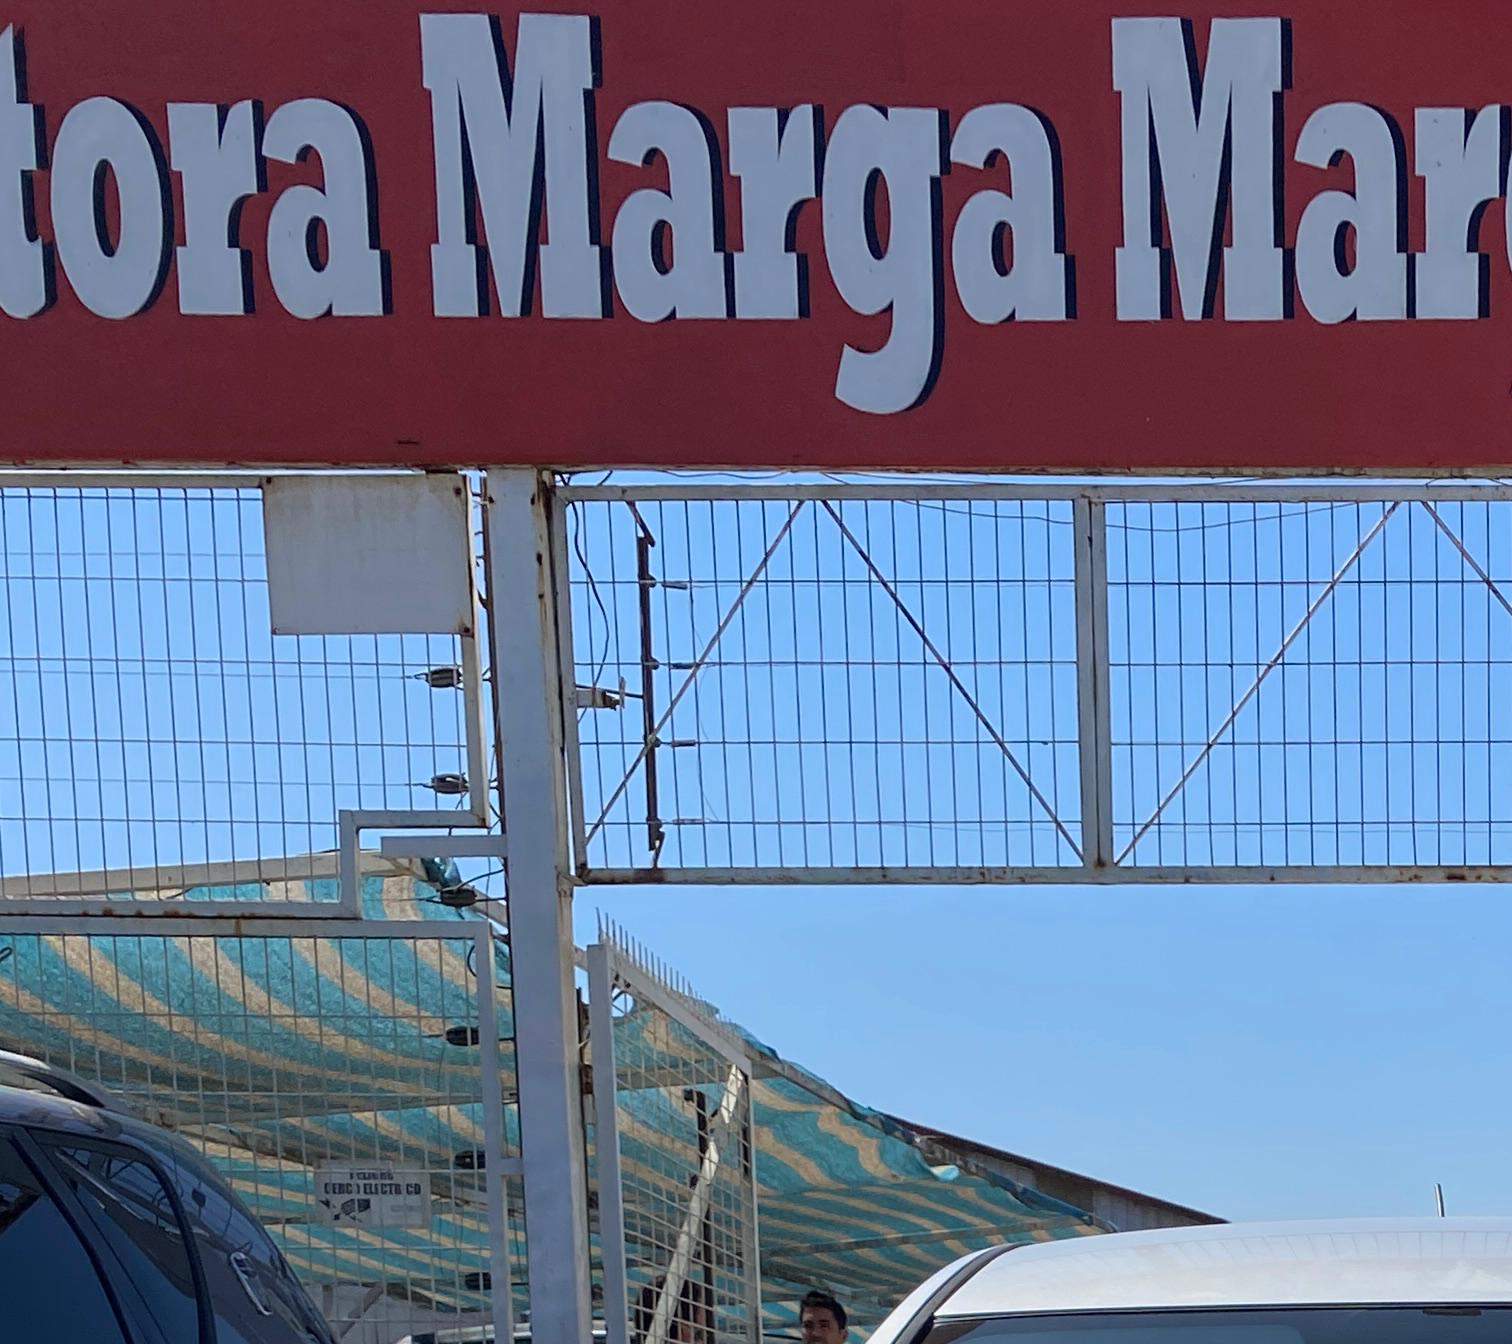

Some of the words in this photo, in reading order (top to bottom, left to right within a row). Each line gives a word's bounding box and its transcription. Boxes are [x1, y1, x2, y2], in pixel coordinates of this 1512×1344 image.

[0, 23, 390, 319] tora
[419, 12, 1076, 414] Marga
[363, 1182, 421, 1195] ELECTRCO
